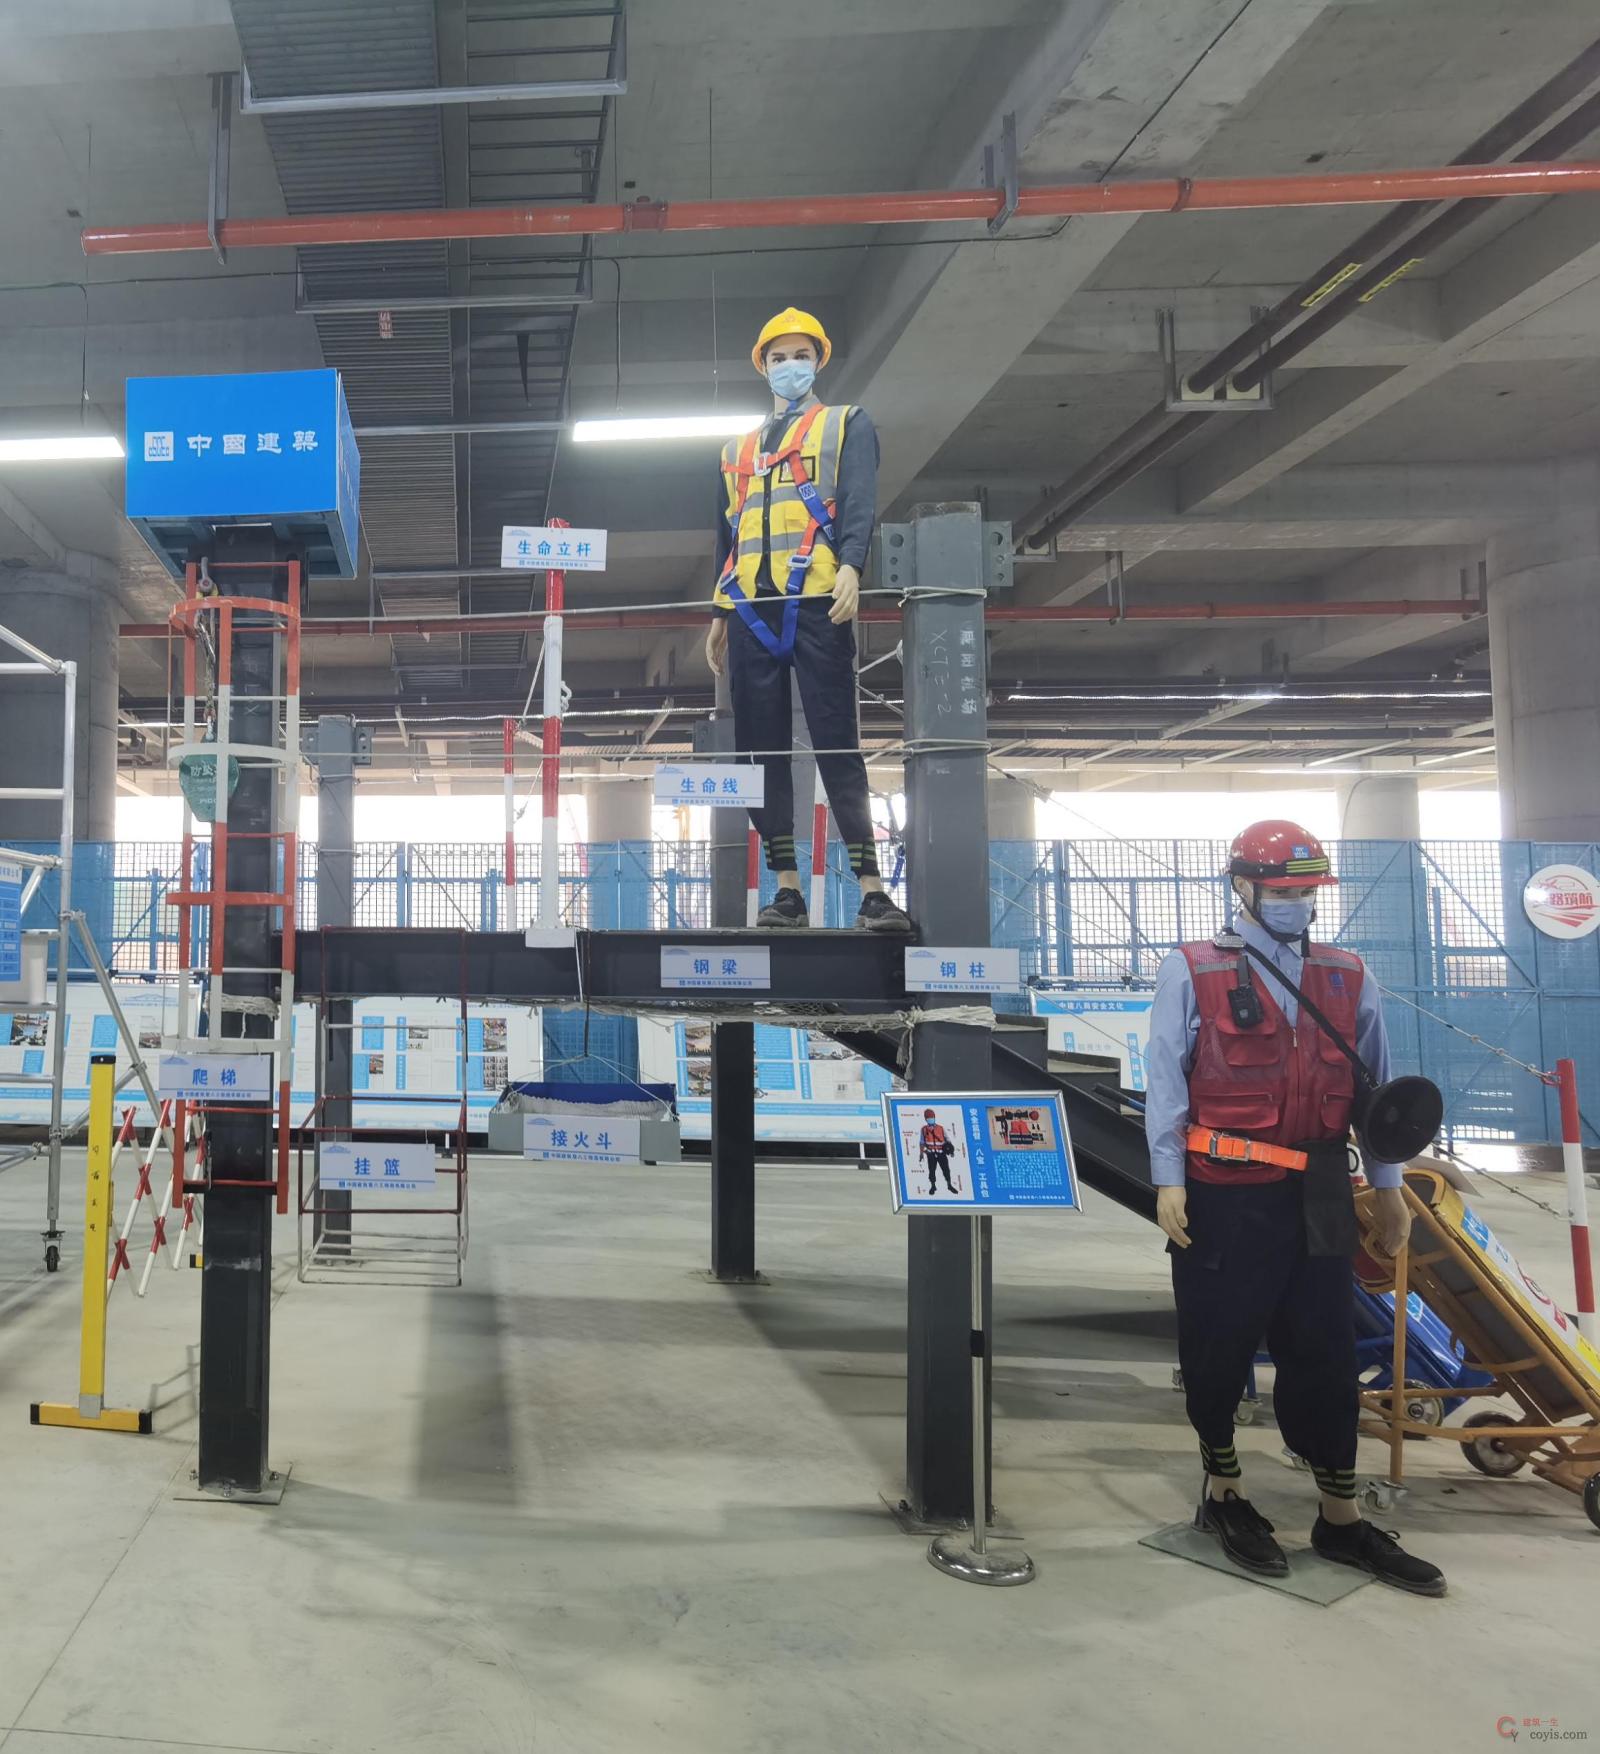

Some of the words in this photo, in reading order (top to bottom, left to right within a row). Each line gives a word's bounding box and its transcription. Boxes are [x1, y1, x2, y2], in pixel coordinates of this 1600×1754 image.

[517, 539, 592, 557] 生命立杆
[680, 777, 738, 794] 生命线
[693, 958, 737, 975] 钢梁
[940, 961, 985, 979] 钢柱
[192, 1068, 236, 1086] 爬梯
[550, 1129, 612, 1151] 接火斗
[354, 1157, 401, 1176] 挂篮
